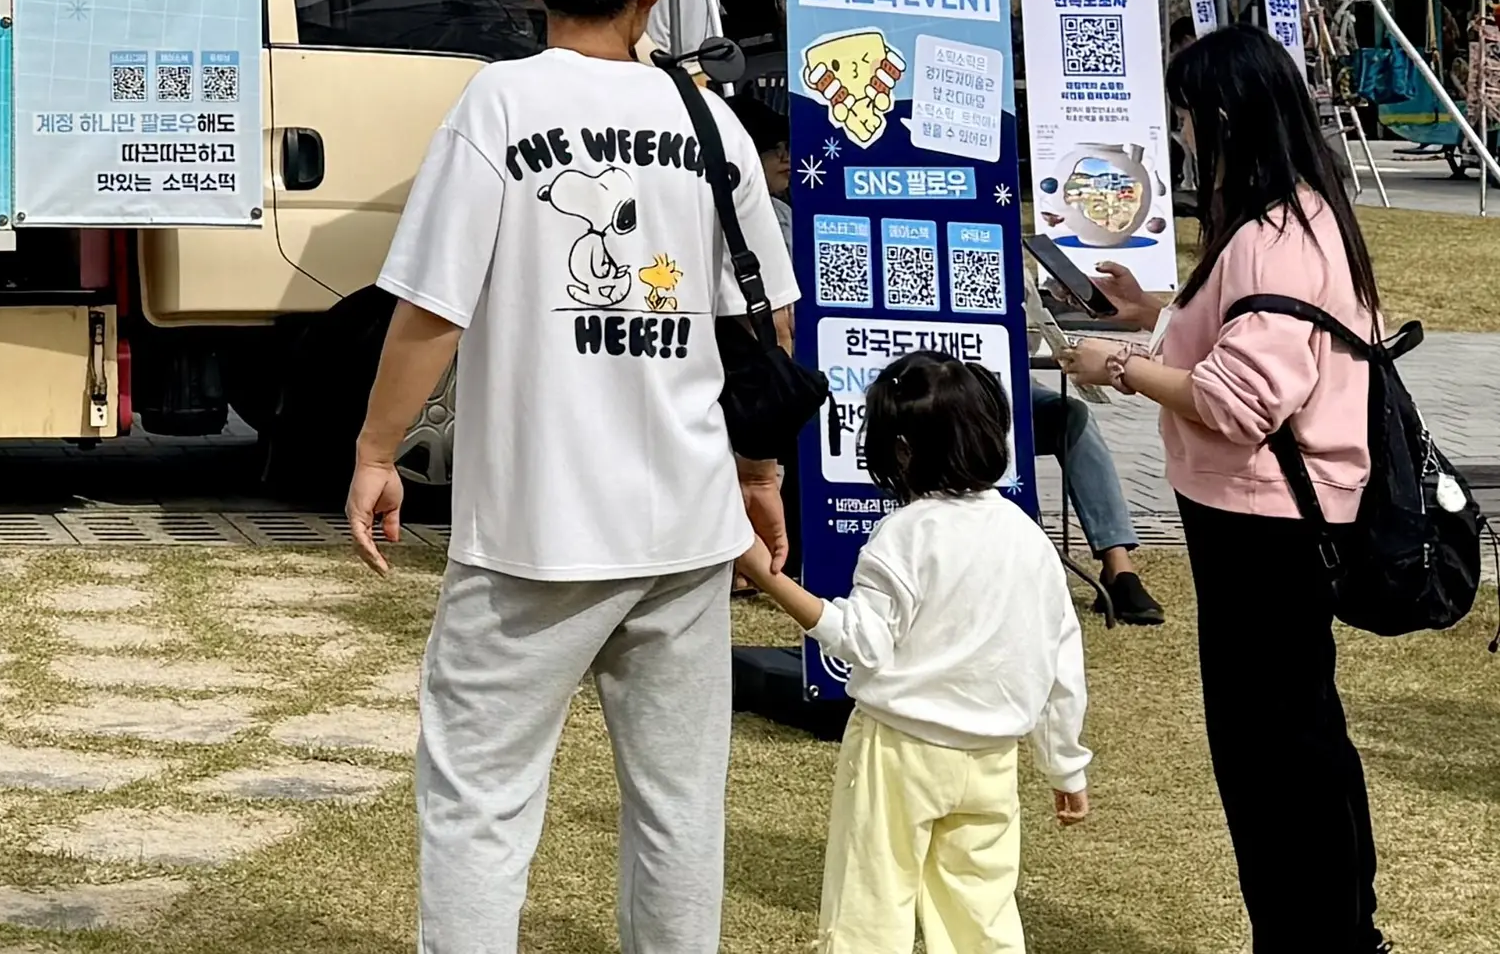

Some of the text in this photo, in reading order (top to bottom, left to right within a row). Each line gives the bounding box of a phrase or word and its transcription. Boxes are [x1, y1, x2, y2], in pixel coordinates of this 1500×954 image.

[36, 113, 236, 133] 계정 하나만 팔로우해도
[121, 143, 236, 163] 따끈따끈하고
[506, 127, 573, 181] THE
[97, 173, 236, 192] 맛있는 소떡소떡
[853, 170, 968, 196] SNS 팔로우
[846, 327, 983, 361] 한국도자재단
